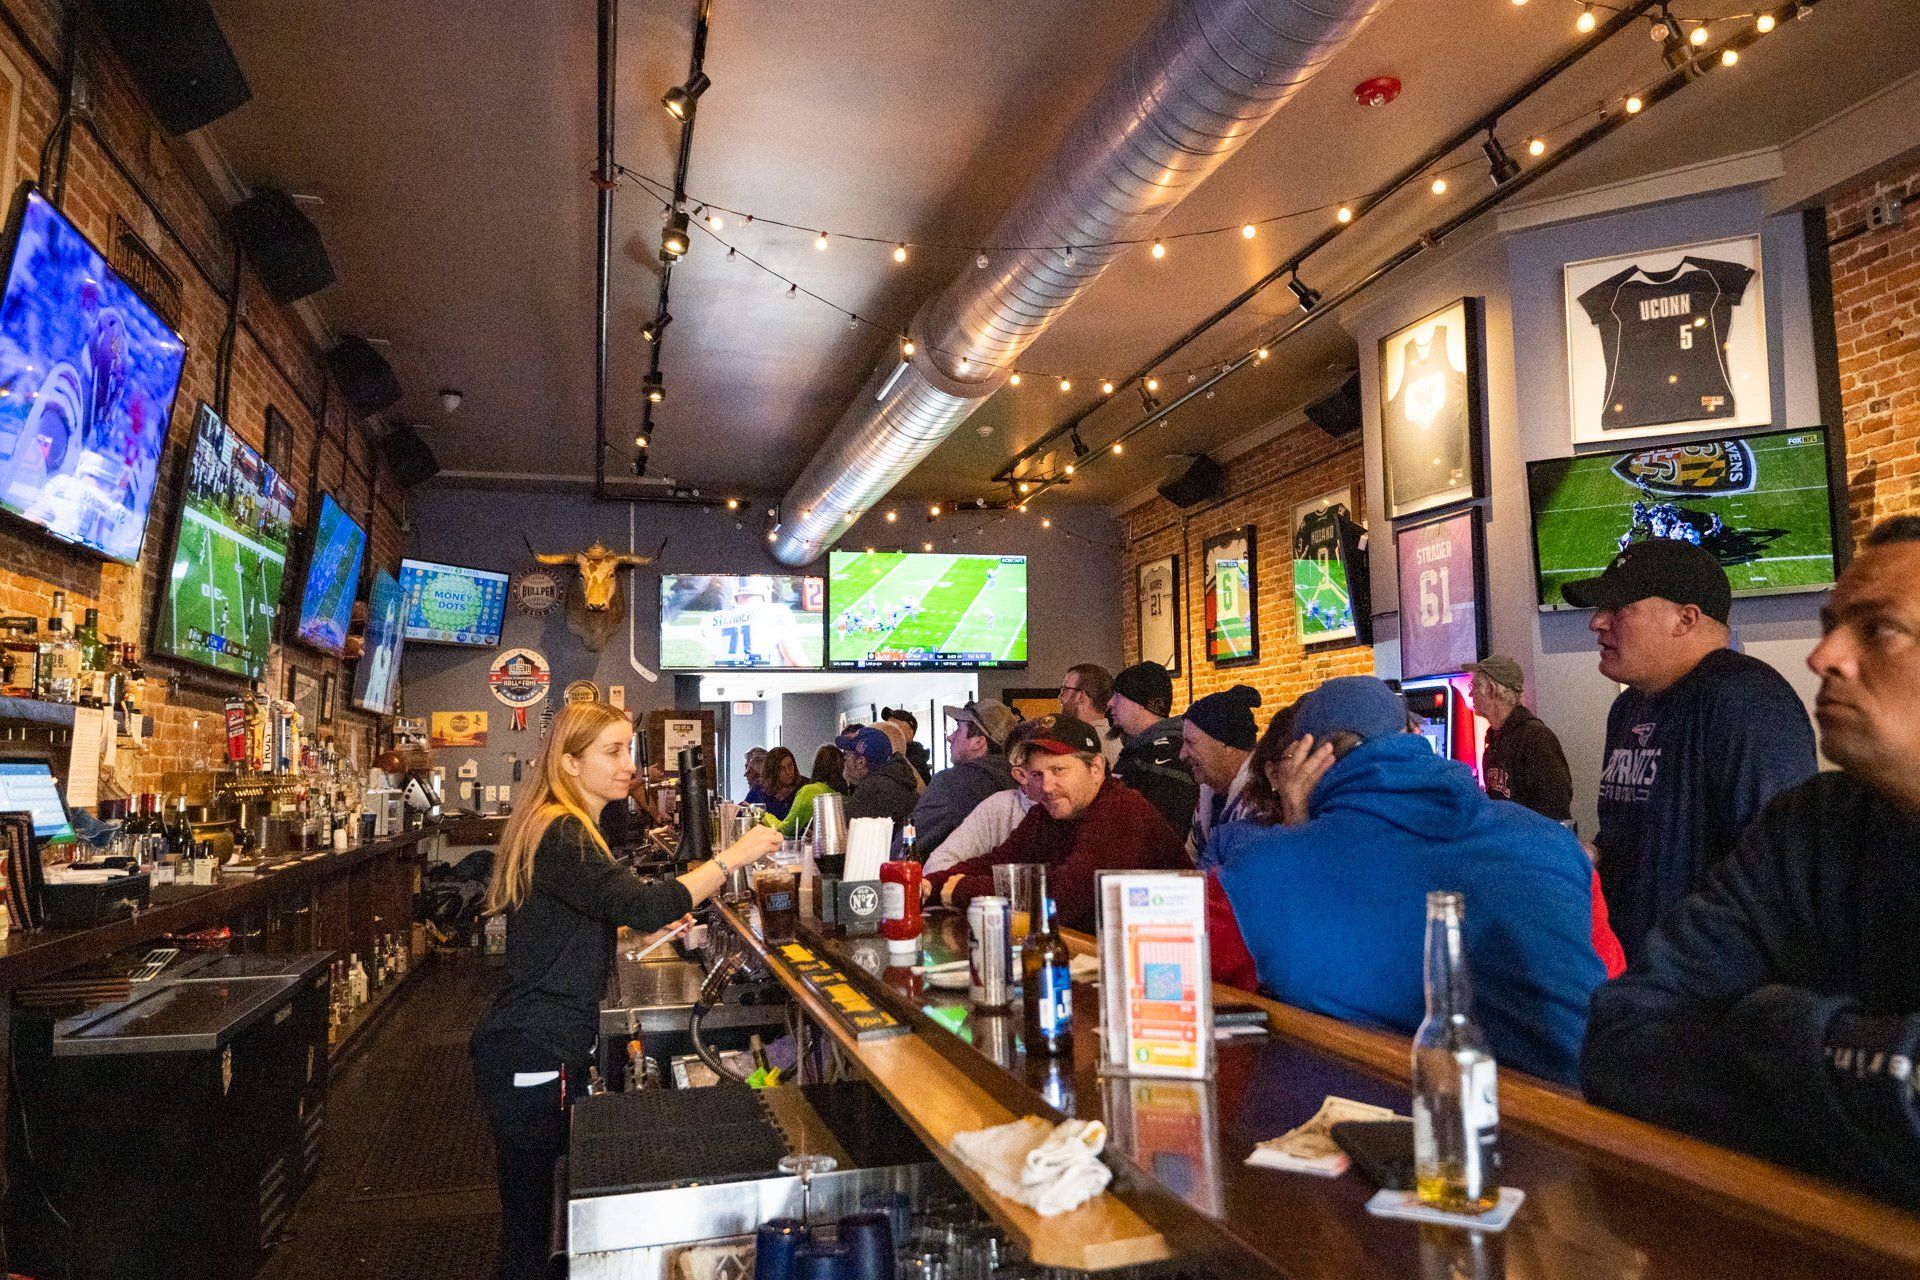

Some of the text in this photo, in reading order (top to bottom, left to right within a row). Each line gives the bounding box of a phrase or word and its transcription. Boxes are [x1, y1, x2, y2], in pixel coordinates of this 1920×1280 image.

[1639, 293, 1691, 321] UCONN
[1679, 323, 1694, 350] 5
[1788, 434, 1818, 446] FOX NFL
[1416, 540, 1453, 565] STRADER
[432, 565, 455, 573] MONEY
[434, 591, 473, 611] MONEY DOTS
[522, 585, 555, 598] BULLPEN
[808, 584, 823, 606] 2
[1419, 566, 1453, 628] 61
[1150, 593, 1163, 617] 21
[721, 625, 752, 654] 71
[735, 704, 752, 714] EXIT
